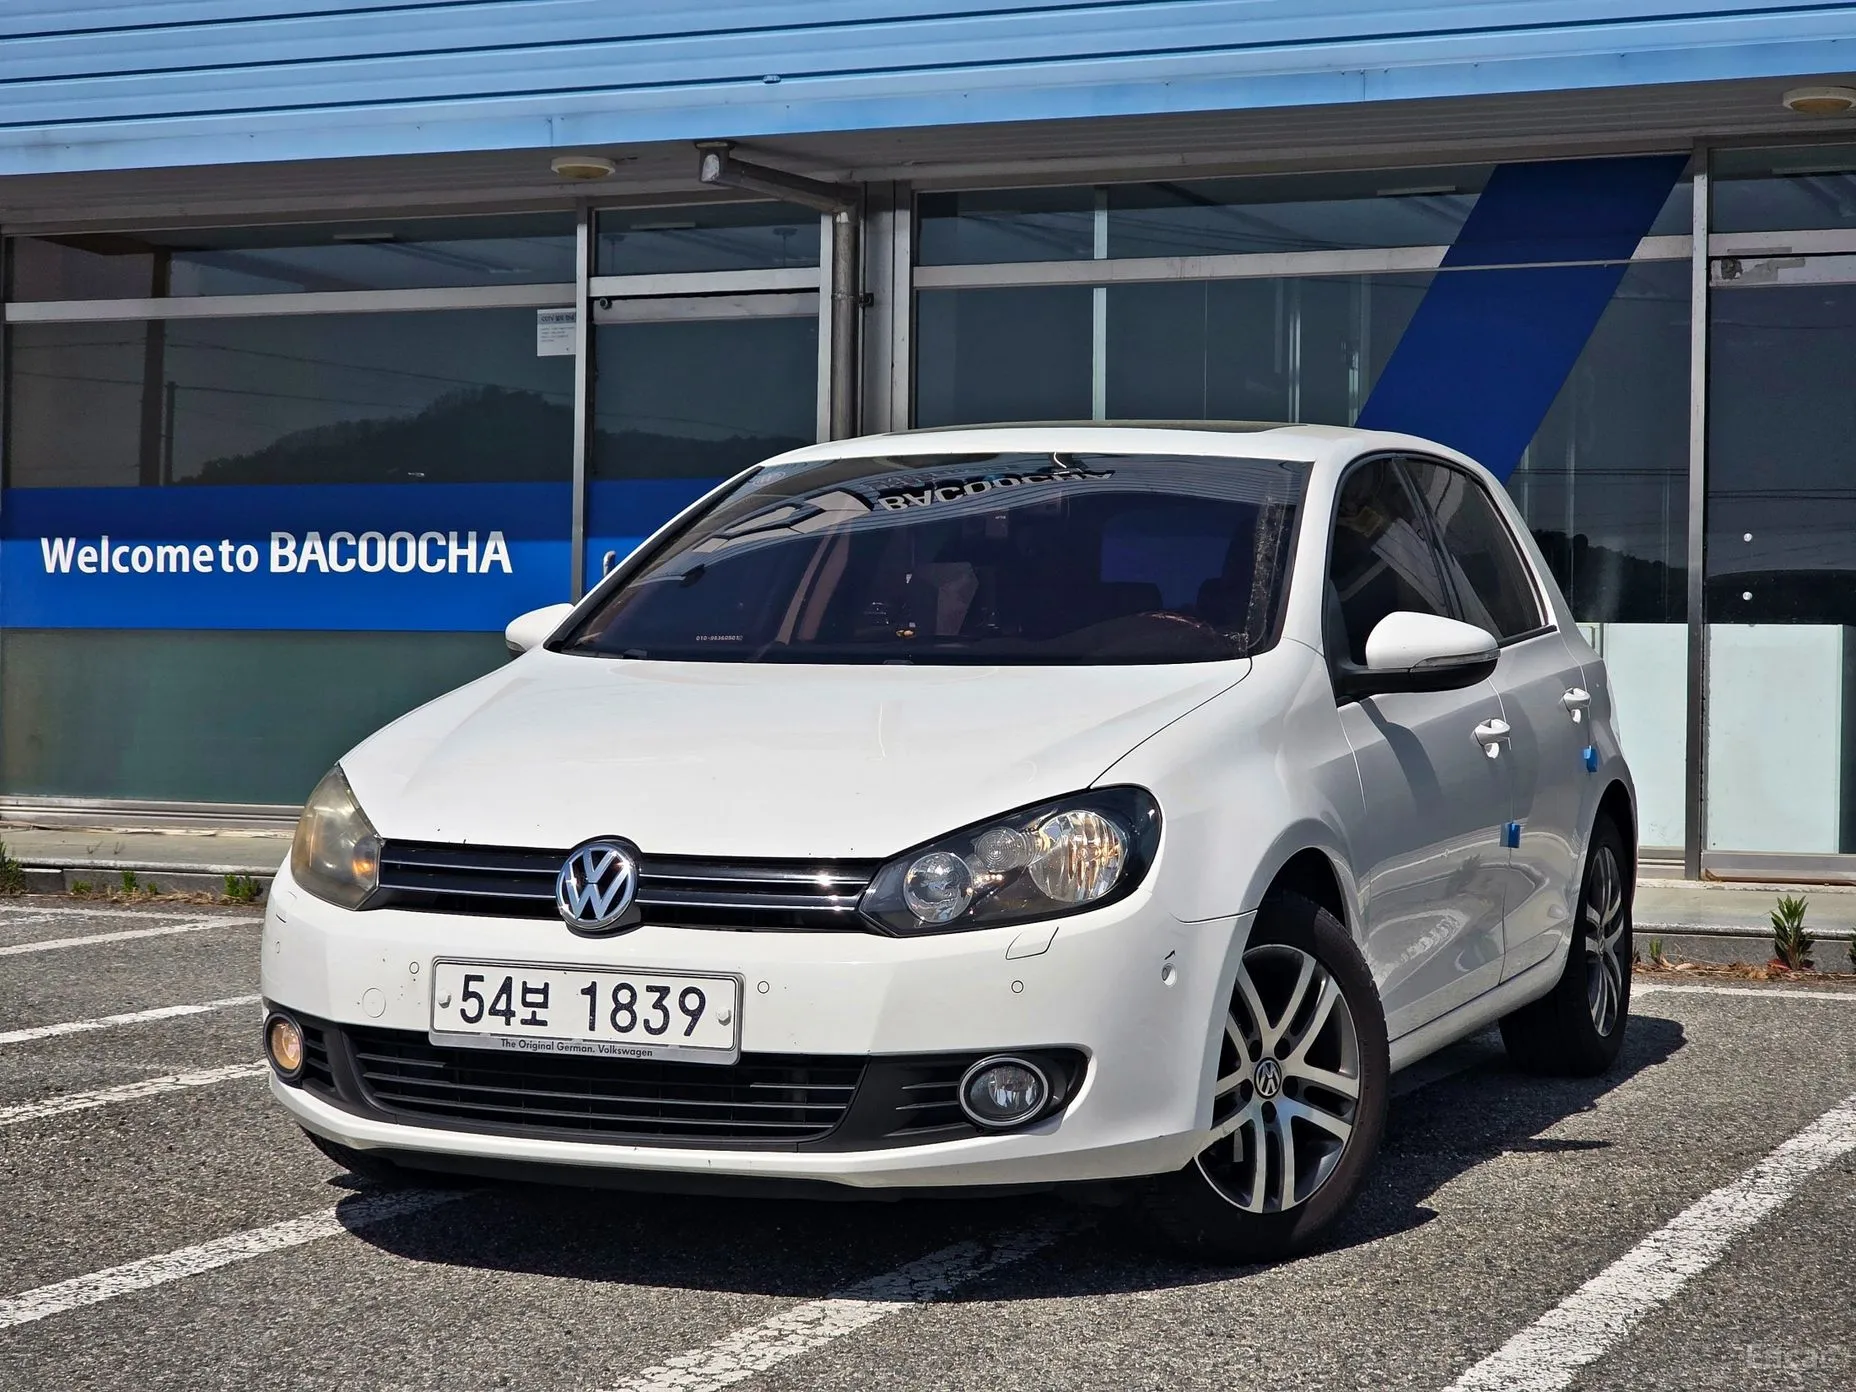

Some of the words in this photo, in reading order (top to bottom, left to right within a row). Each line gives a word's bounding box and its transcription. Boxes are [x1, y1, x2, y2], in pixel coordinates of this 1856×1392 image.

[40, 535, 214, 573] Welcome
[219, 539, 259, 572] to
[269, 531, 513, 574] BACOOCHA
[459, 973, 550, 1027] 54보
[580, 980, 707, 1037] 1839
[501, 1038, 516, 1049] The
[518, 1039, 554, 1052] Original
[598, 1044, 653, 1058] Volkswagen
